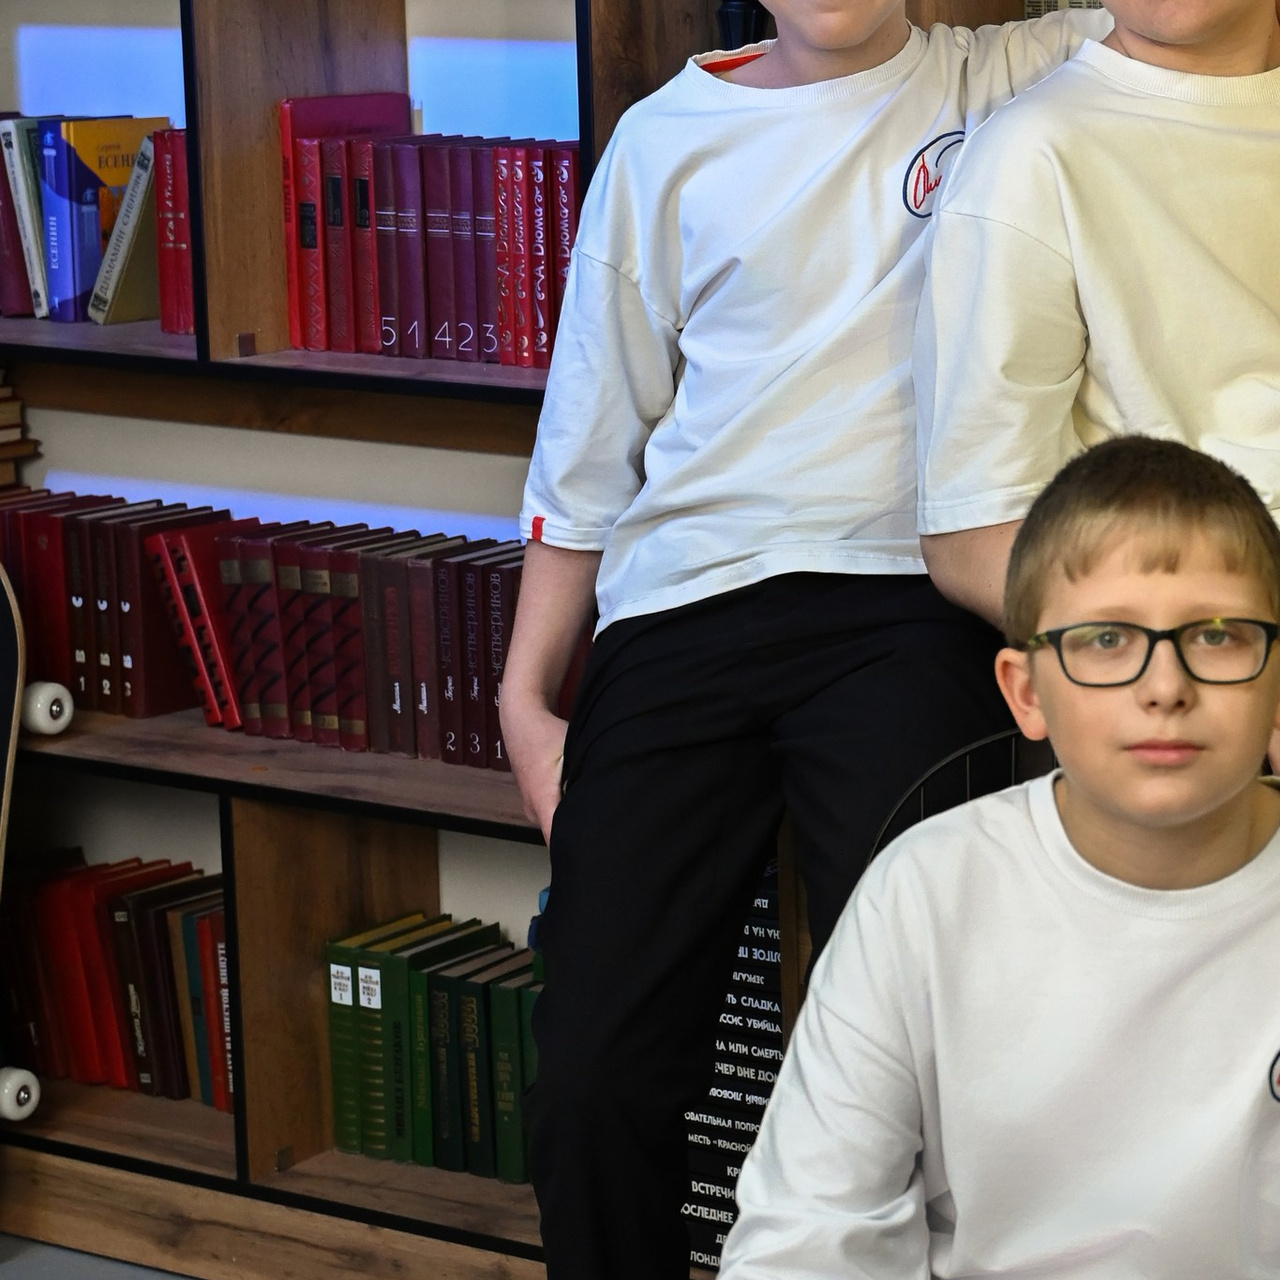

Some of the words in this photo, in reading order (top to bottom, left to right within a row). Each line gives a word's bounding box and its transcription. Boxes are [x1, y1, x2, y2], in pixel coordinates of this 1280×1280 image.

[49, 216, 59, 270] ЕСЕНИН
[533, 208, 545, 256] Дюма
[558, 208, 570, 258] Дюма
[534, 260, 545, 280] А.
[381, 317, 396, 346] 5
[407, 320, 420, 349] 1
[434, 321, 453, 349] 4
[457, 322, 474, 352] 2
[483, 323, 498, 353] 3
[446, 731, 456, 751] 2
[469, 733, 481, 754] 3
[741, 996, 781, 1013] СЛАДКА
[746, 1017, 782, 1034] УБИЙЦА
[728, 1041, 748, 1055] ИЛИ
[751, 1045, 784, 1061] СМЕРТЬ
[737, 1066, 756, 1080] ВНЕ
[688, 1133, 711, 1146] МЕСТЬ
